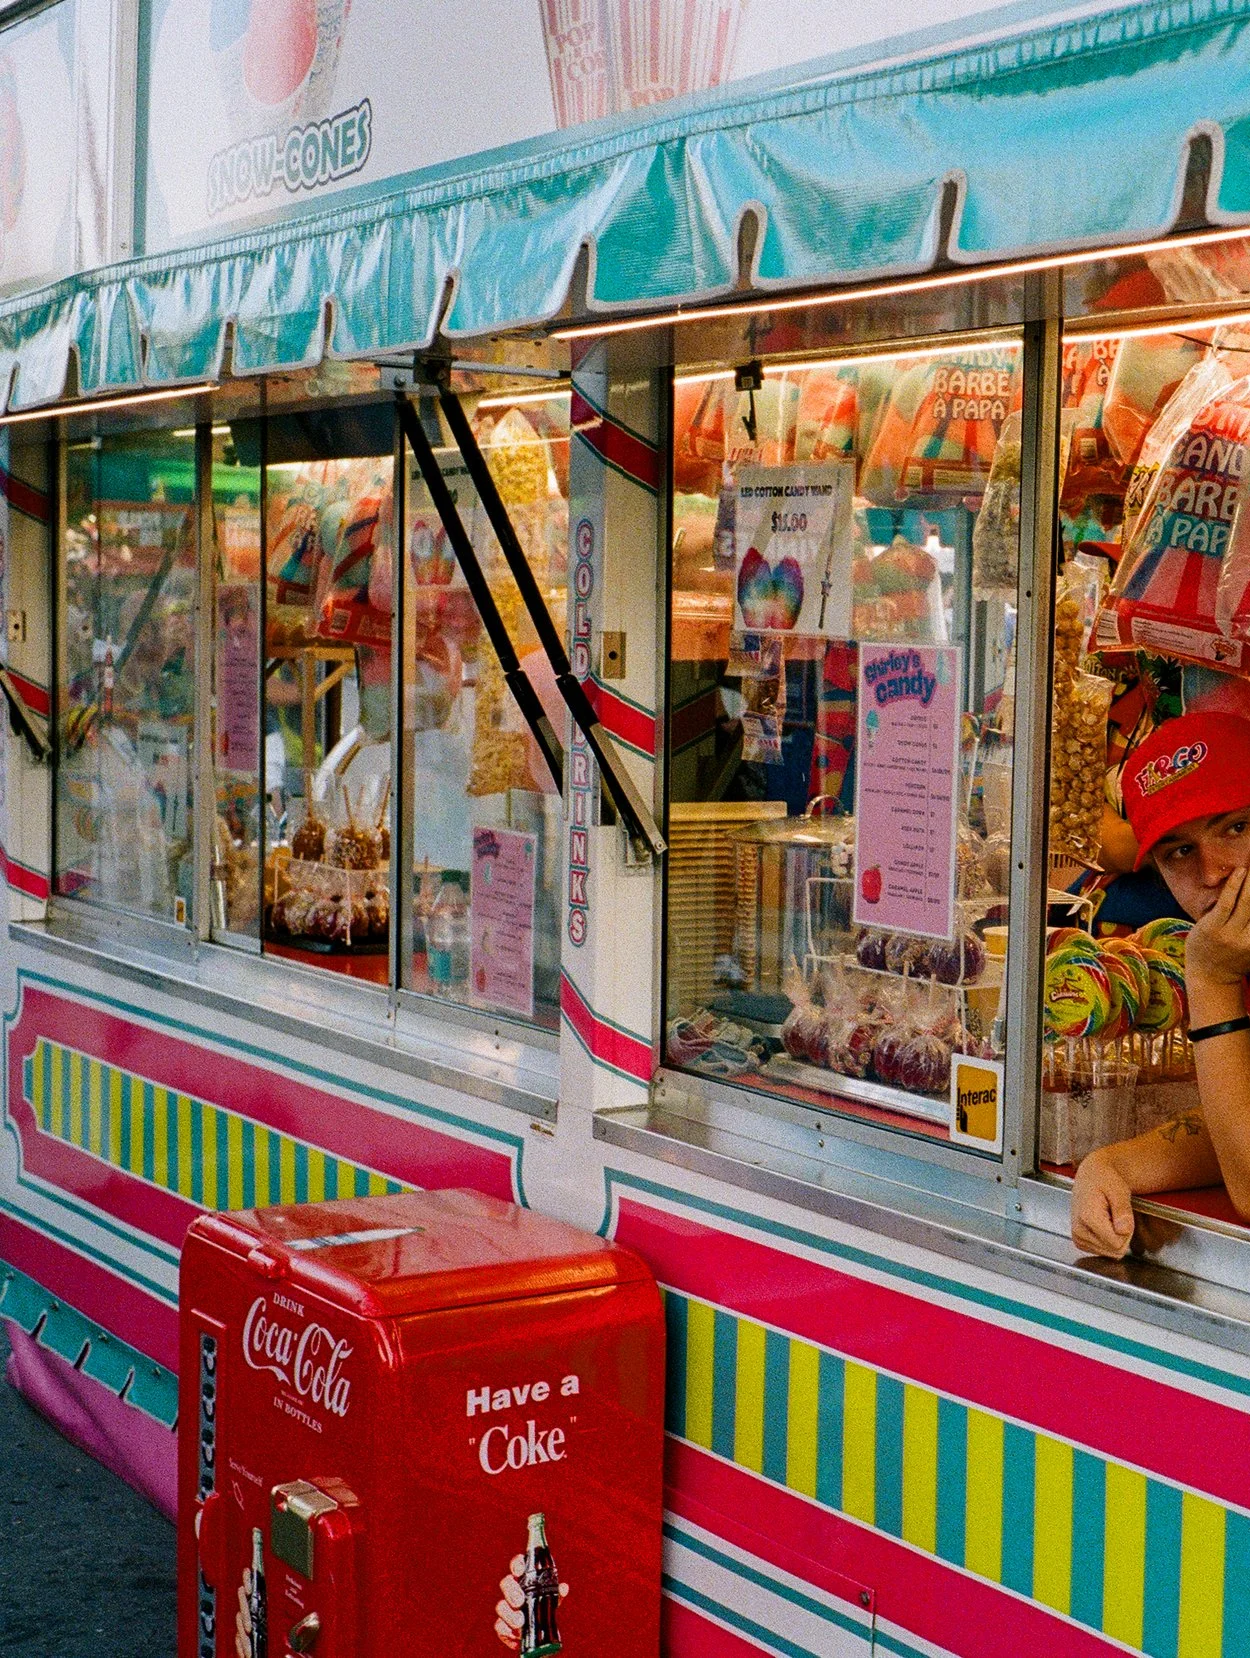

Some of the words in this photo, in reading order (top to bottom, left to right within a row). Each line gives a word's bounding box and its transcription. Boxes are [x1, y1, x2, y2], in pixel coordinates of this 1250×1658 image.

[574, 518, 594, 681] COLD
[876, 669, 936, 704] candy
[1135, 741, 1208, 796] FARGO
[957, 1087, 997, 1107] Interac
[273, 1292, 305, 1318] DRINK
[466, 1380, 551, 1417] Have
[560, 1374, 580, 1397] a
[273, 1396, 283, 1410] IN
[284, 1402, 323, 1434] BOTTLES
